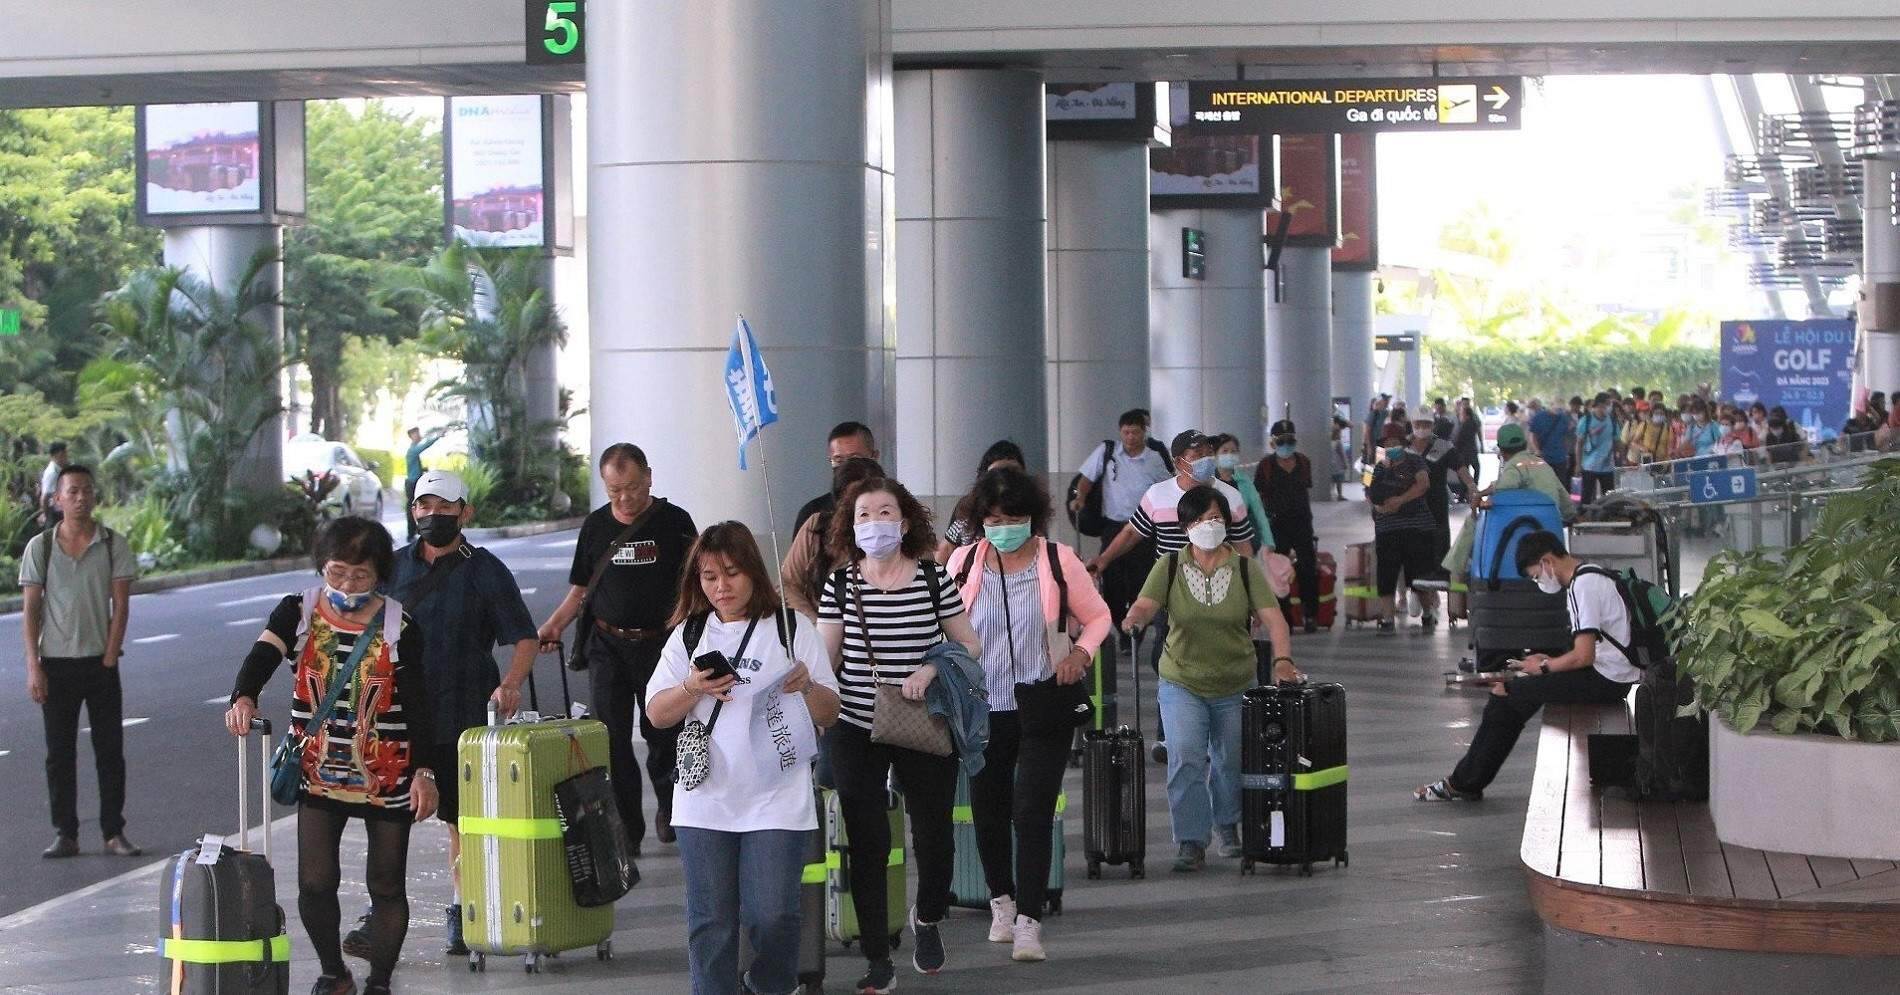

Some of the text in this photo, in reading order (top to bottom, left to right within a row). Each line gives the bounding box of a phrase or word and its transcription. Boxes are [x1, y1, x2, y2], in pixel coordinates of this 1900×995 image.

[544, 2, 579, 55] 5
[1212, 88, 1437, 106] INTERNATIONAL DEPARTURES
[1346, 104, 1438, 124] Ga đi quốc tế
[1774, 348, 1832, 371] GOLF
